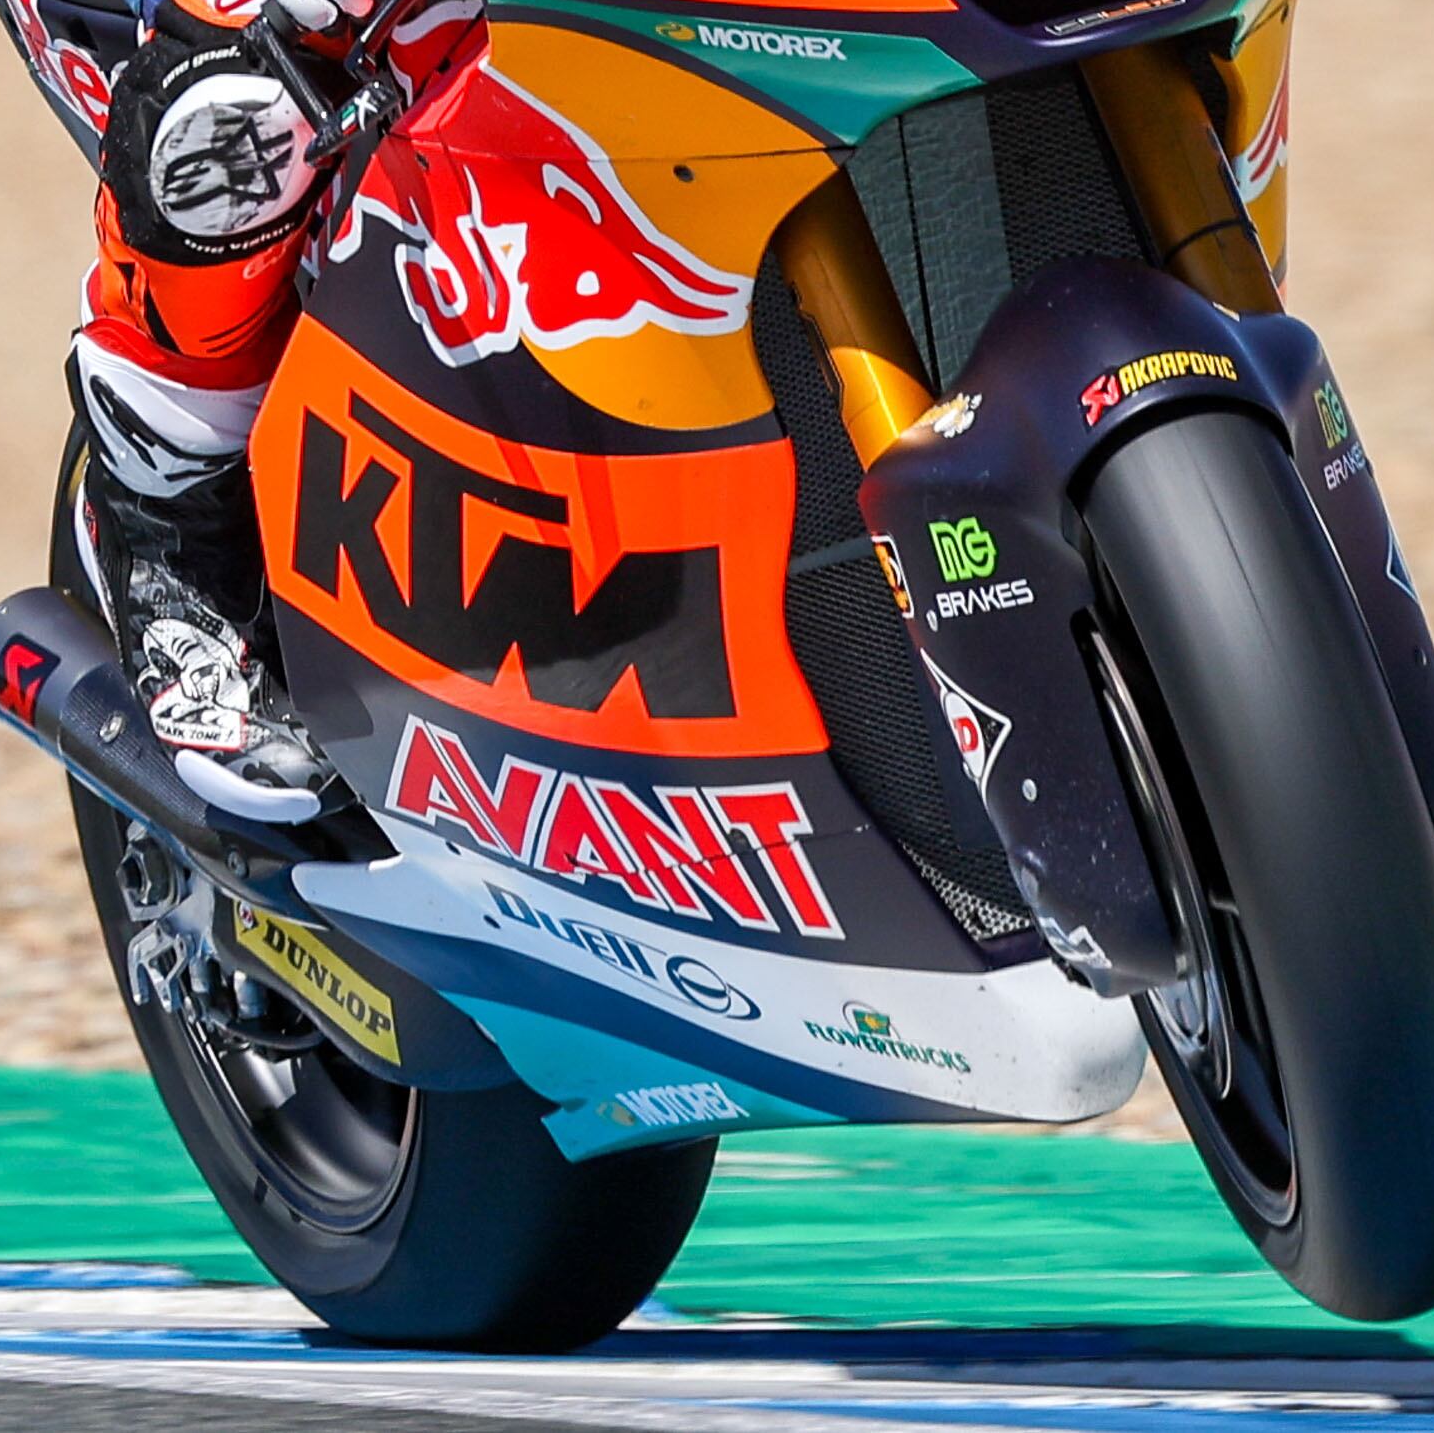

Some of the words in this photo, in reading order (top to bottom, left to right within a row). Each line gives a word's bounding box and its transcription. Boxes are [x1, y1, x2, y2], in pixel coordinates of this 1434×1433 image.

[699, 24, 846, 61] MOTOREX
[291, 387, 738, 720] KTM
[936, 579, 1034, 618] BRAKES
[385, 713, 847, 941] AVANT
[263, 919, 391, 1035] DUNLOP
[804, 1020, 972, 1074] FLOWERTRUCKS
[618, 1081, 750, 1127] MOTOREX
